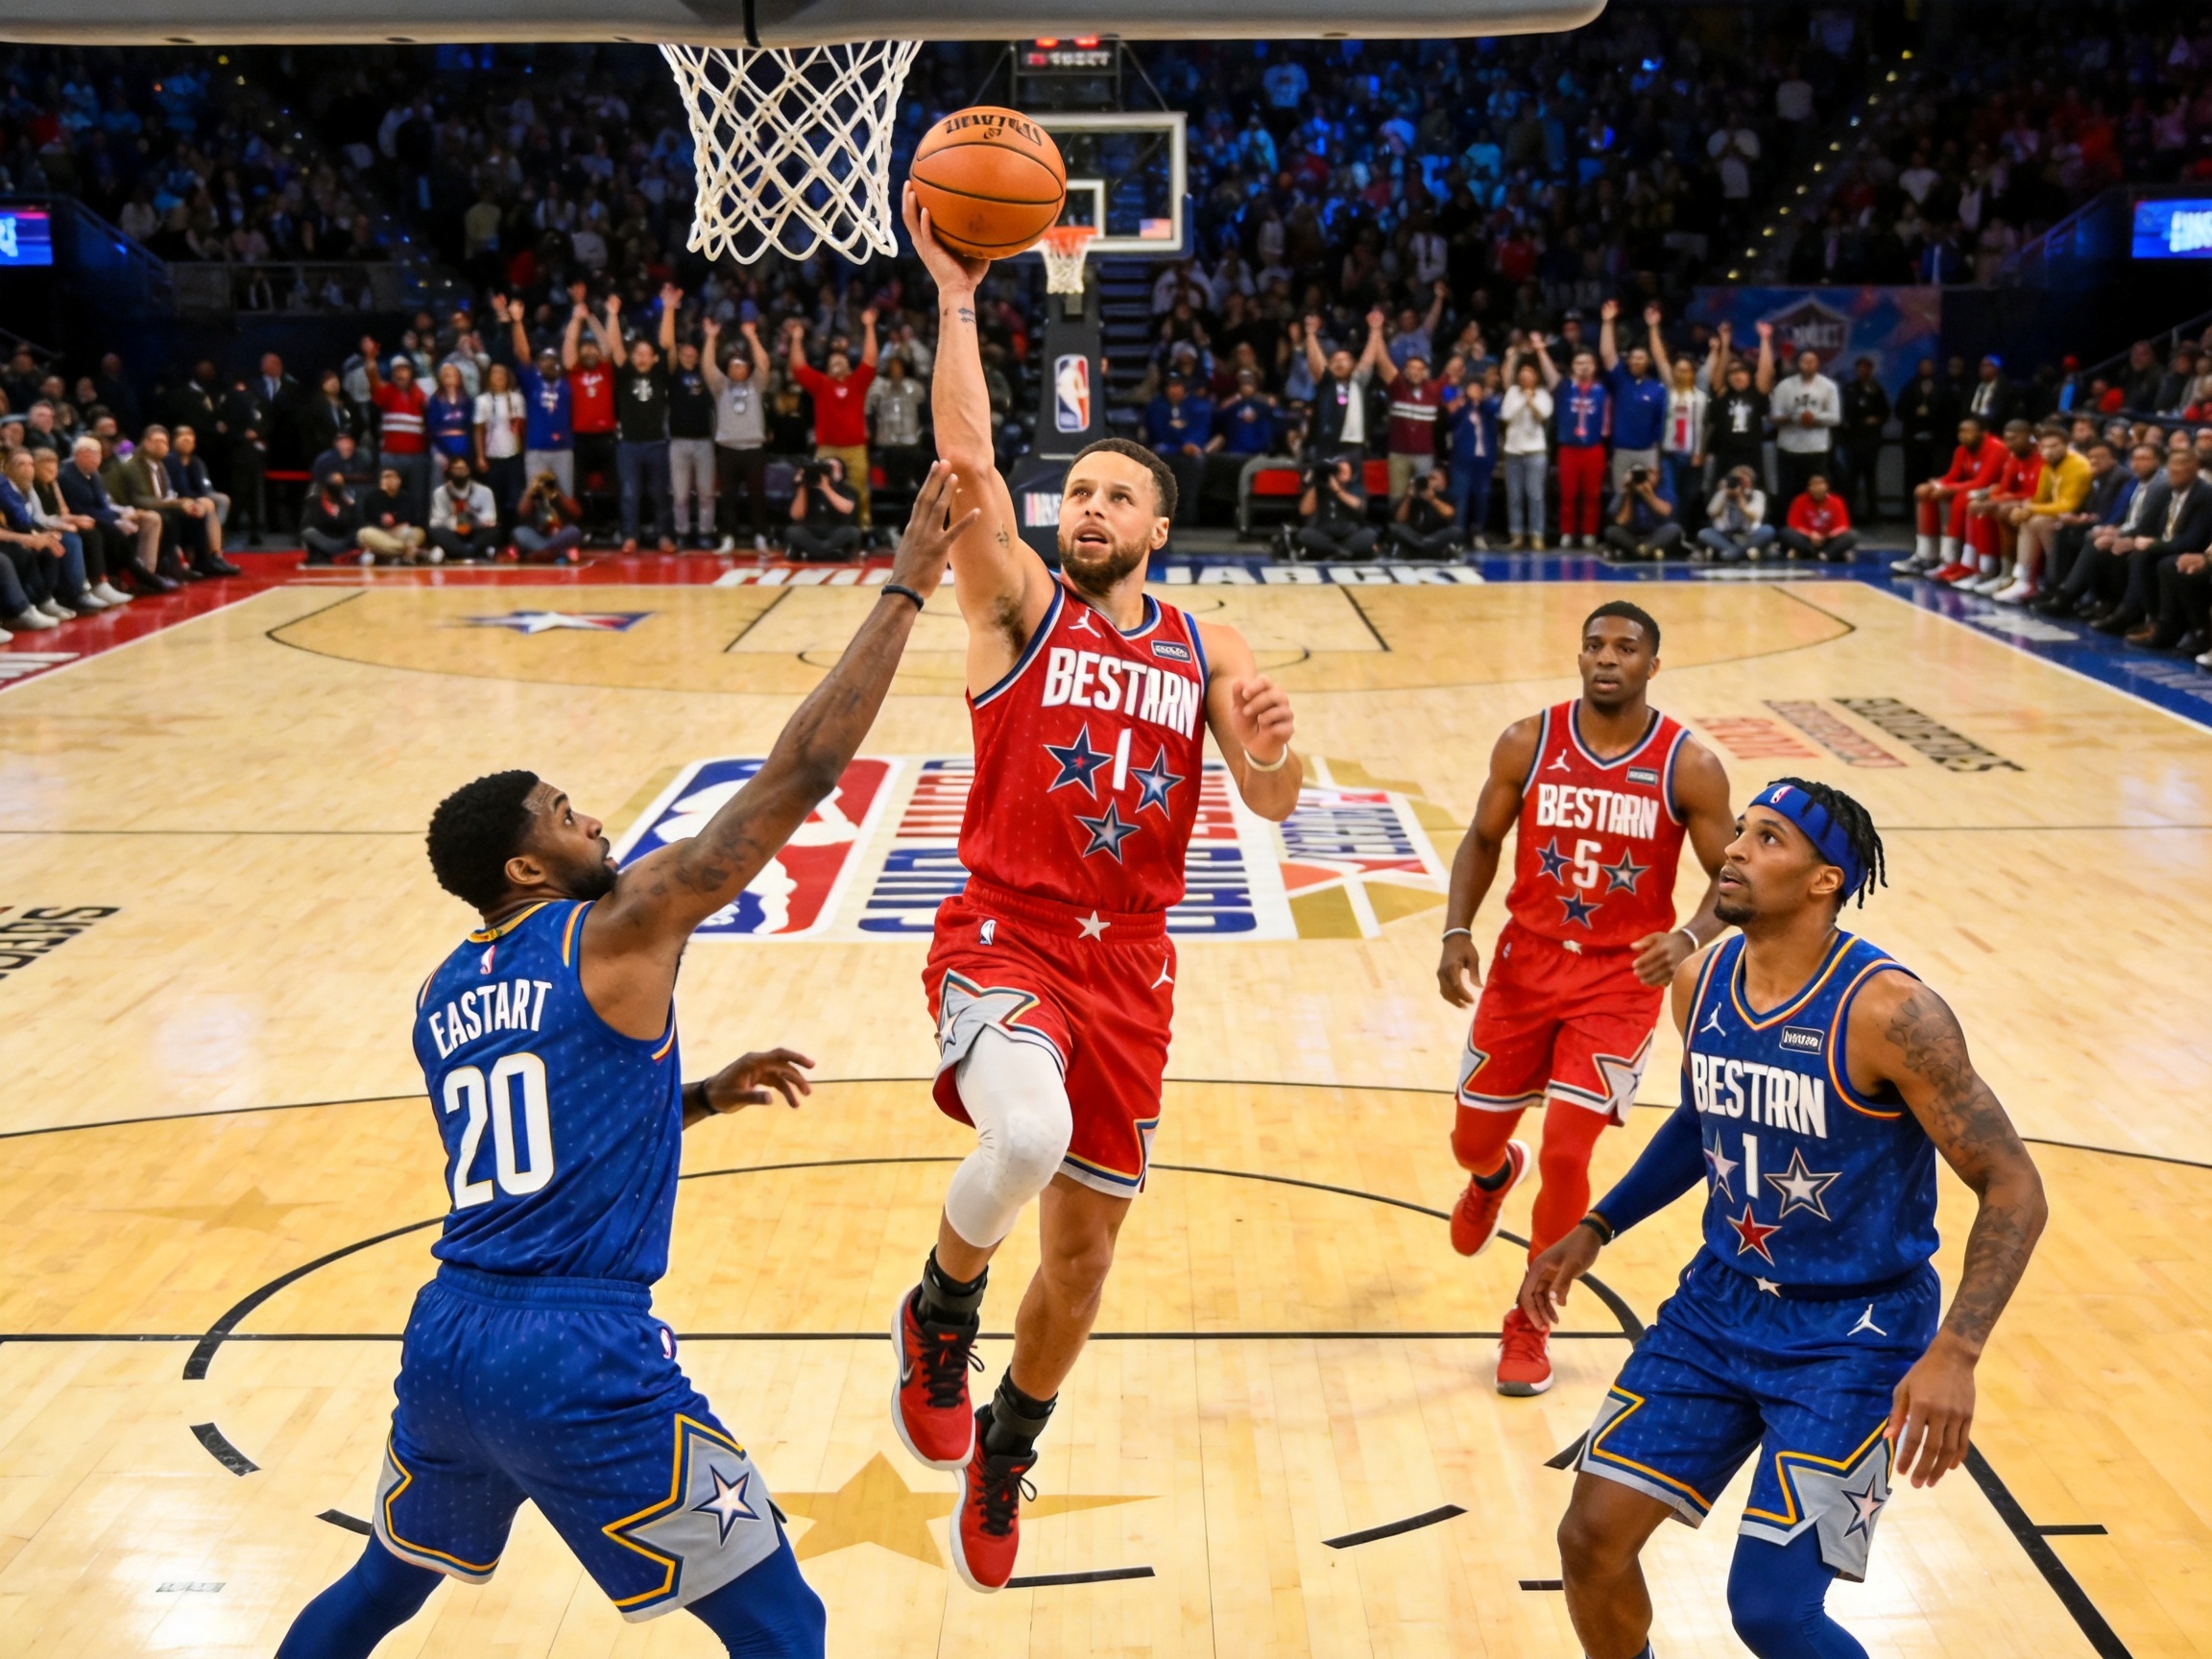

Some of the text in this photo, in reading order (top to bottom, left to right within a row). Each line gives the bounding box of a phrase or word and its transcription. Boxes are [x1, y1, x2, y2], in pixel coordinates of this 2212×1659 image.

[1041, 647, 1200, 740] BESTARN
[1536, 783, 1660, 840] BESTARN
[1572, 839, 1602, 889] 5
[428, 978, 553, 1060] EASTART
[443, 1052, 555, 1210] 20
[1691, 1051, 1828, 1140] BESTARN
[1743, 1133, 1760, 1200] 1
